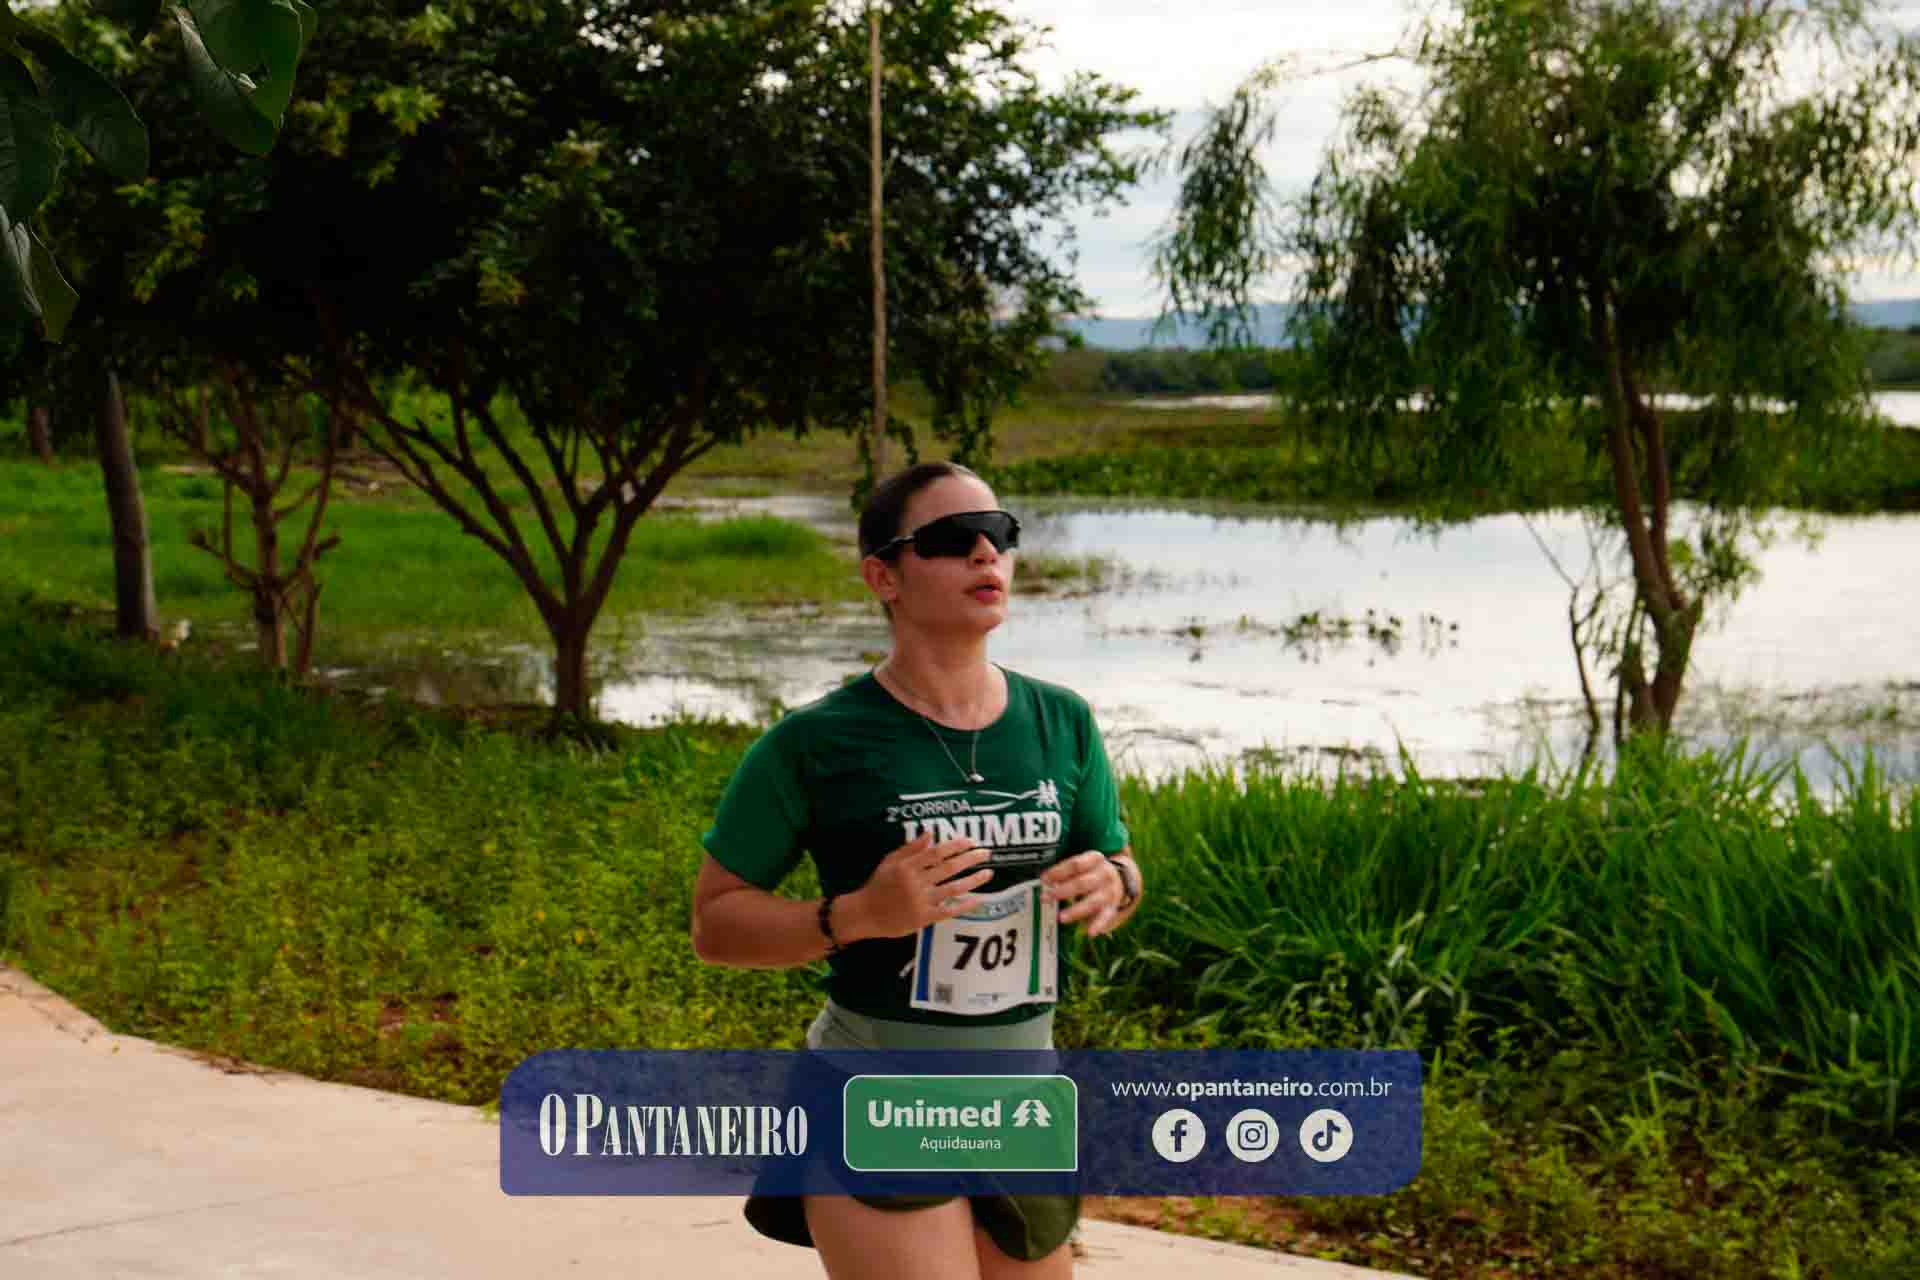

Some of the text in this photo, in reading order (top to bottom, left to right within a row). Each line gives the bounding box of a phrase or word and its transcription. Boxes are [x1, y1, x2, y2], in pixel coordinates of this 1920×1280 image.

[901, 799, 972, 819] CORRIDA
[903, 811, 1062, 848] UNIMED
[952, 928, 1018, 971] 703
